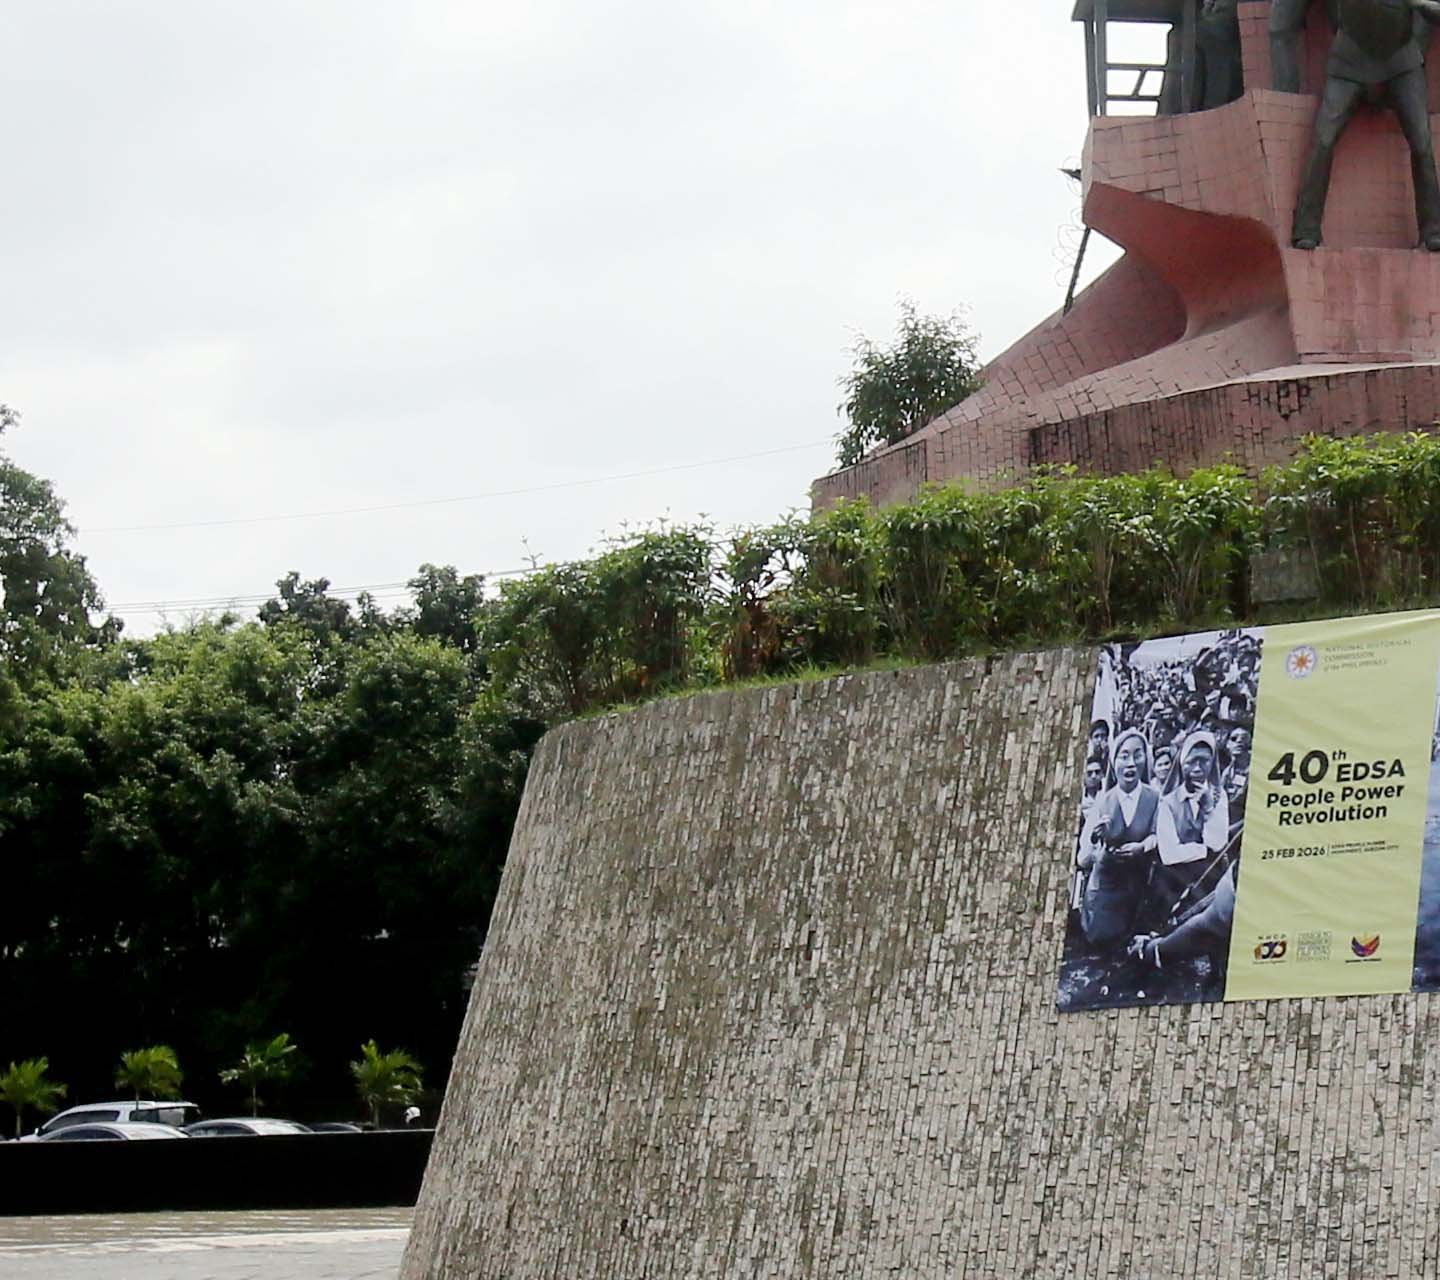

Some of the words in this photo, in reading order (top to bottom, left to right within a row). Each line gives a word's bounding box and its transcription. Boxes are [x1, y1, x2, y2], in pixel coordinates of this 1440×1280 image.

[1336, 759, 1406, 782] EDSA
[1267, 788, 1335, 808] People
[1341, 785, 1404, 801] Power
[1279, 804, 1387, 826] Revolution
[1261, 849, 1274, 860] 25
[1276, 848, 1295, 858] FEB
[1297, 845, 1325, 857] 2026
